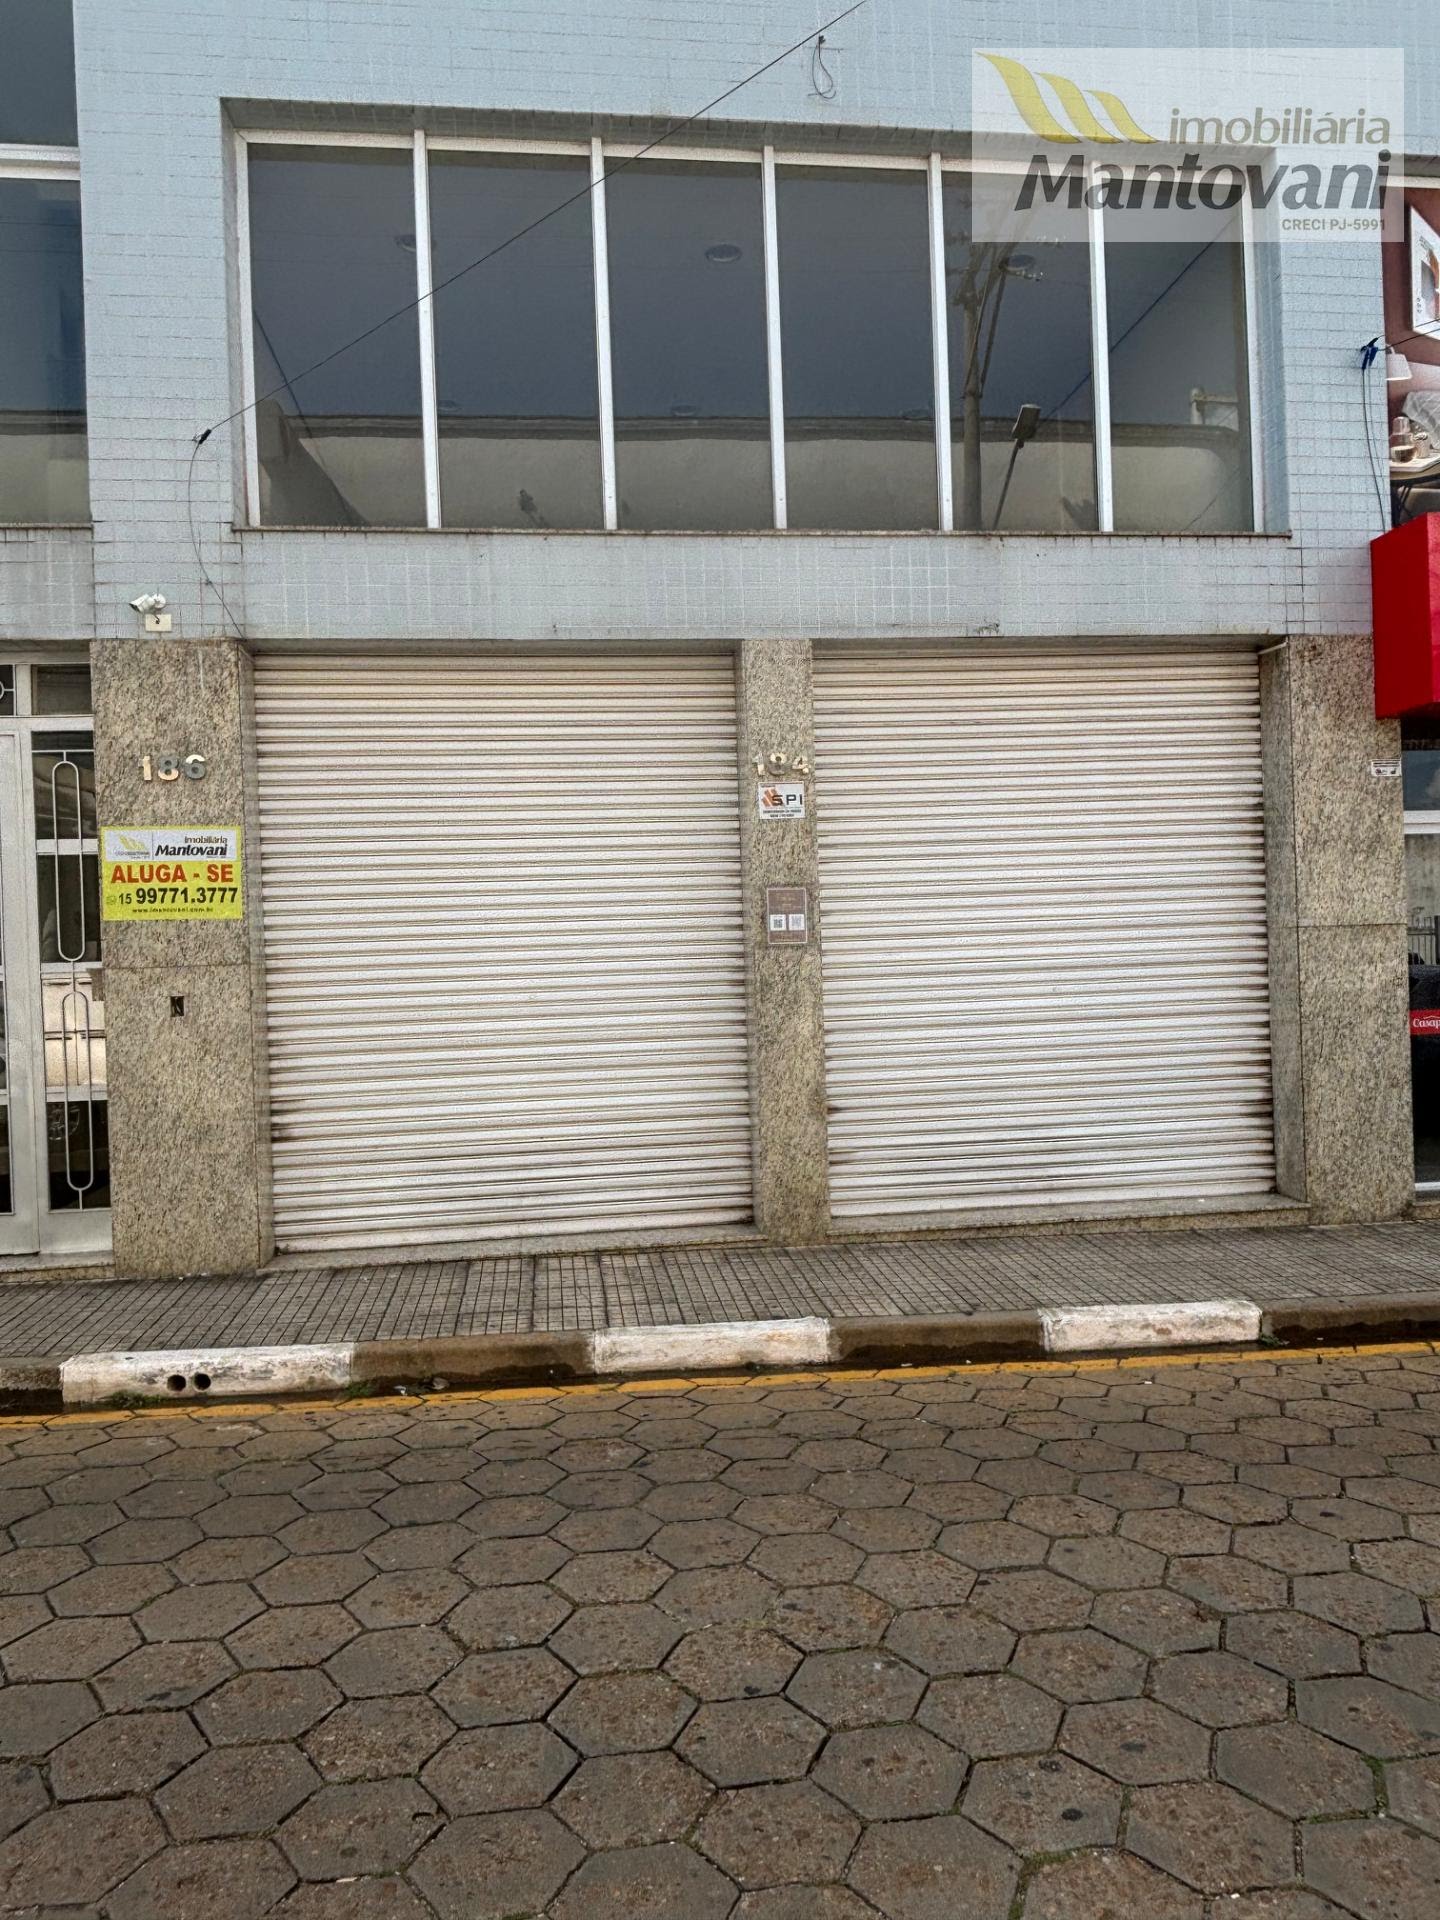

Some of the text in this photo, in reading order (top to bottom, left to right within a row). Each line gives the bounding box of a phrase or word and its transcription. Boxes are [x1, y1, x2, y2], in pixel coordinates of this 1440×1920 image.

[139, 754, 207, 781] 186
[155, 844, 228, 857] Mantovani
[110, 864, 188, 884] ALUGA
[207, 863, 234, 883] SE
[118, 887, 238, 905] 15 99771.3777
